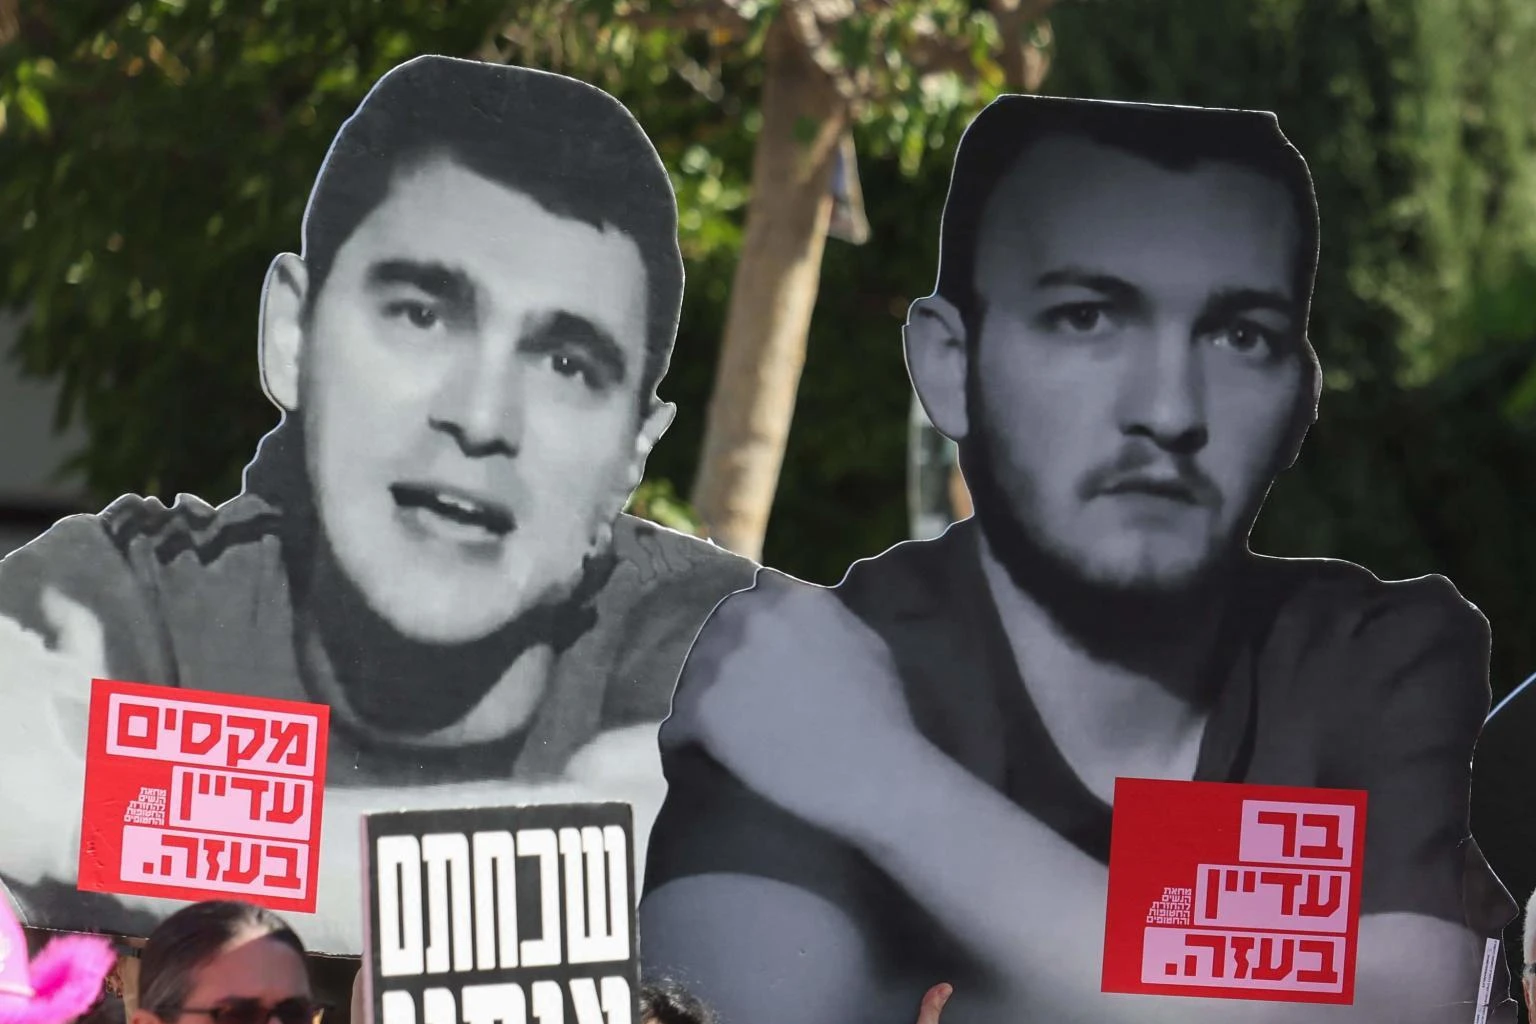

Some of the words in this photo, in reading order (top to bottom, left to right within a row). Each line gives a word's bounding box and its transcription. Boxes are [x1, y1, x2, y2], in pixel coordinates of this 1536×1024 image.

[117, 703, 310, 767] מקסים
[180, 772, 305, 824] עדיין
[1257, 811, 1343, 860] בר
[143, 834, 301, 889] בעזה.
[377, 825, 630, 976] שכחתם
[1152, 901, 1191, 911] להחזרת
[1161, 894, 1191, 904] הנשים
[1163, 887, 1192, 896] מחאת
[1205, 869, 1341, 919] עדיין
[1164, 934, 1338, 983] בעזה.
